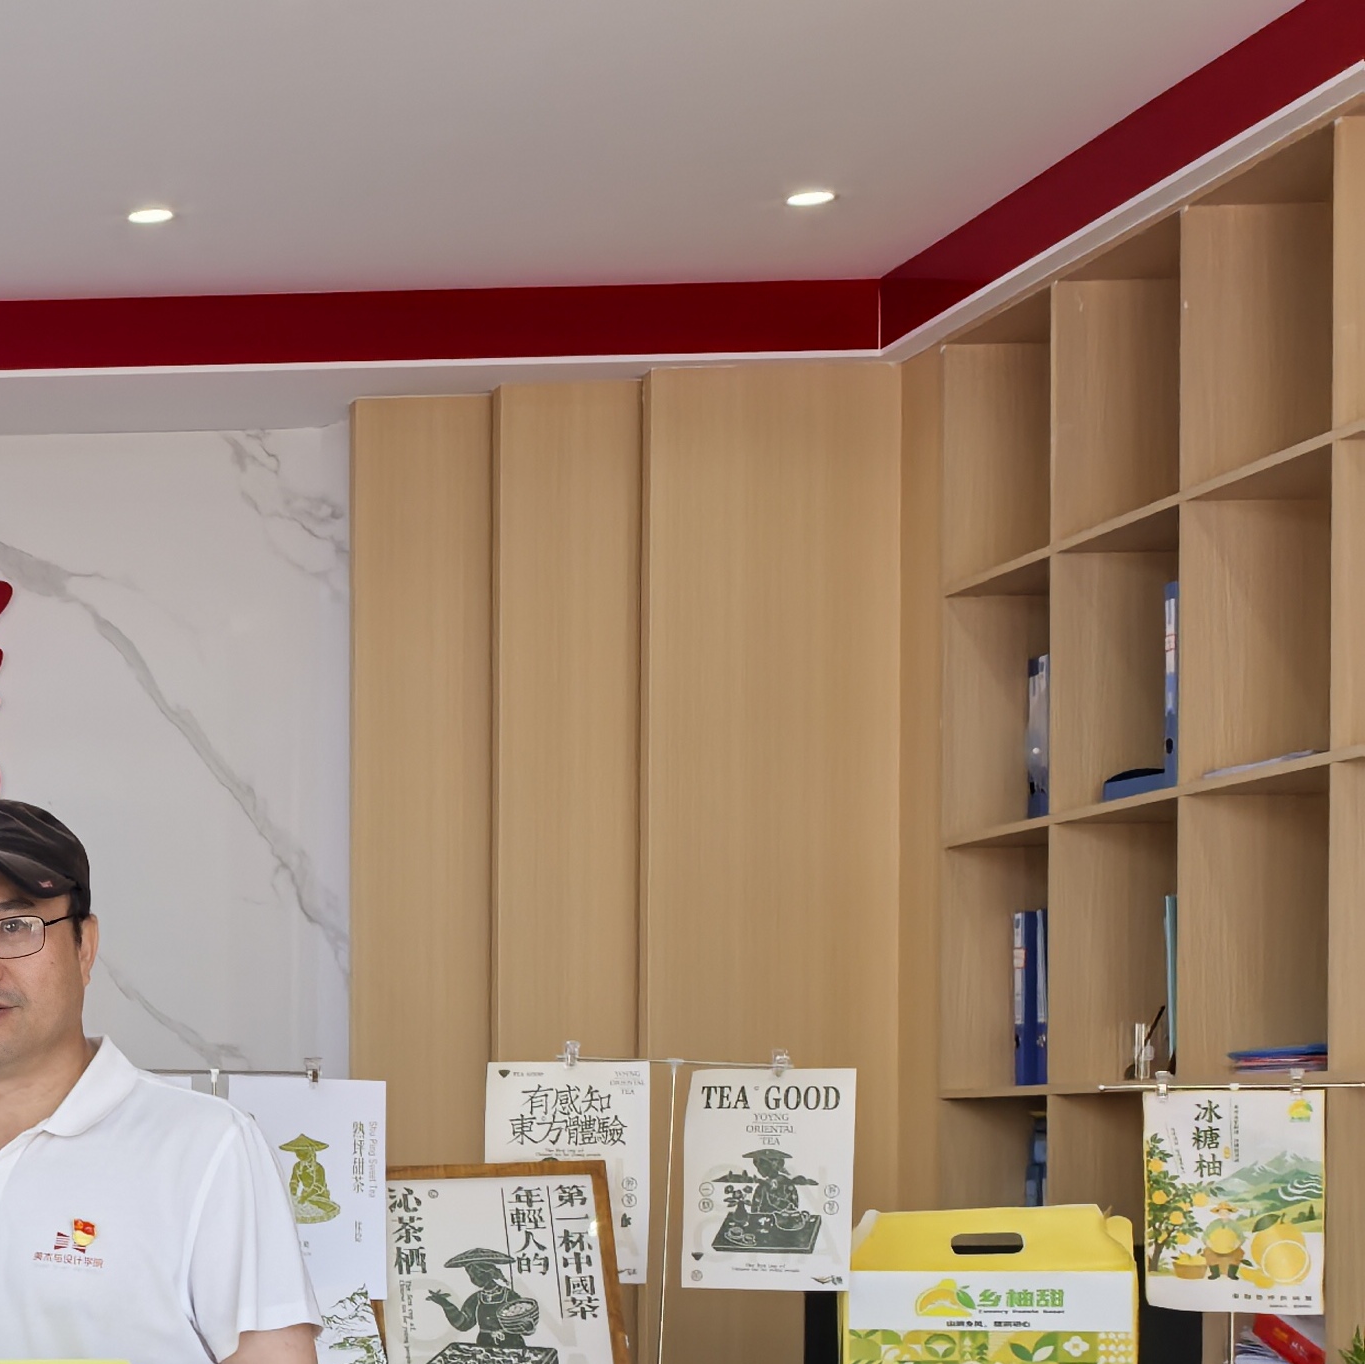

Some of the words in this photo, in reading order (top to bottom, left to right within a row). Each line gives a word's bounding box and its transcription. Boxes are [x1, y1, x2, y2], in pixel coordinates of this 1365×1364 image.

[521, 1084, 611, 1115] 有感知
[701, 1085, 750, 1110] TEA
[764, 1085, 841, 1111] GOOD
[506, 1113, 628, 1146] 東方體驗
[746, 1125, 795, 1133] ORIENTAL
[760, 1137, 780, 1145] TEA
[1192, 1100, 1223, 1178] 冰糖柚
[508, 1185, 549, 1276] 年輕人的
[553, 1184, 600, 1321] 第一杯中國茶
[977, 1288, 1065, 1308] 乡柚甜
